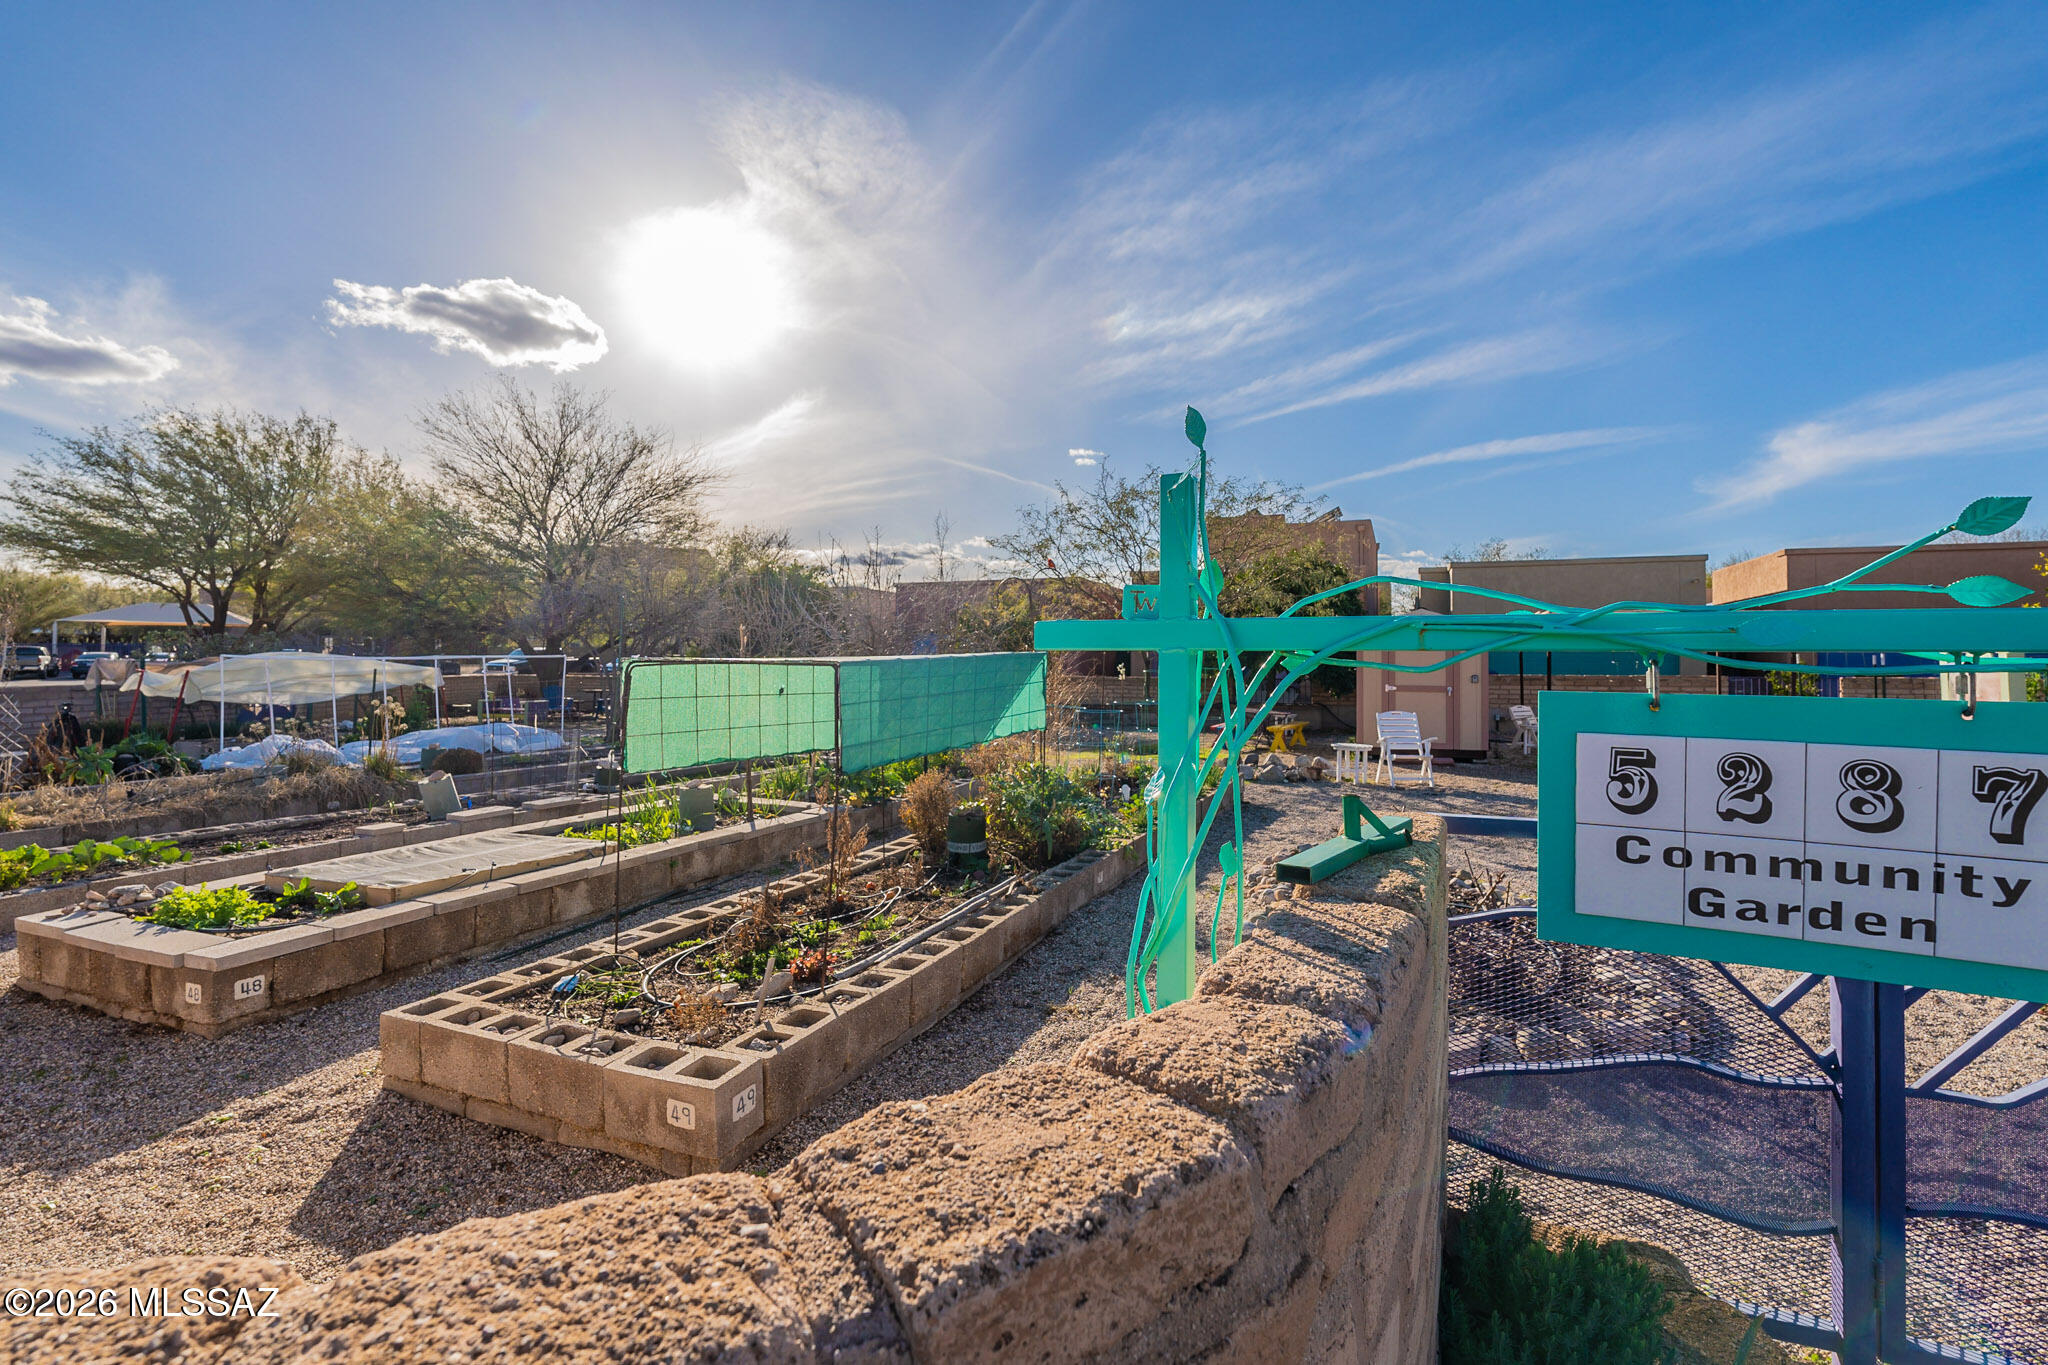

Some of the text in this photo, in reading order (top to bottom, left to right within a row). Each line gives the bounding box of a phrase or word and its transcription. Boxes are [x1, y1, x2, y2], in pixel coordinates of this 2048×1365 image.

[1605, 746, 2048, 845] 5287
[1615, 834, 2032, 908] Community
[1688, 887, 1937, 944] Garden
[241, 979, 262, 995] 48
[671, 1104, 691, 1125] 49
[736, 1088, 755, 1113] 49
